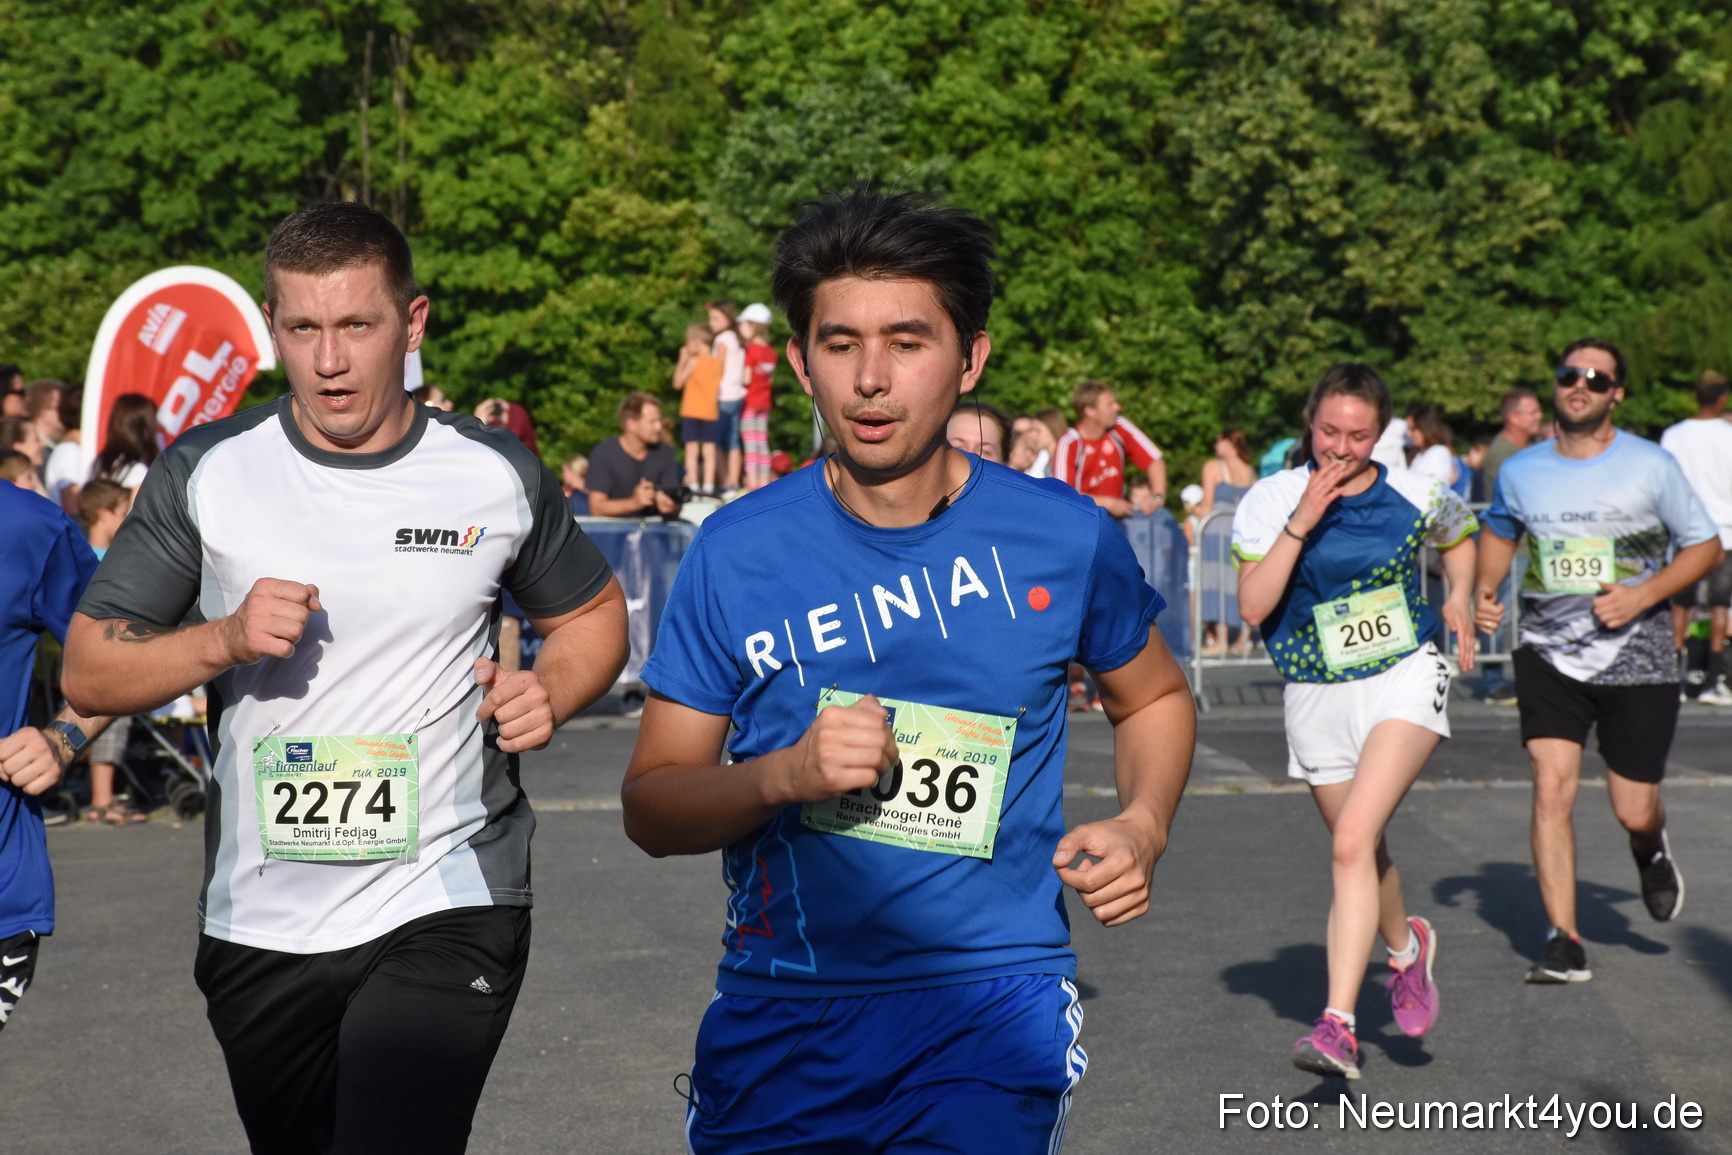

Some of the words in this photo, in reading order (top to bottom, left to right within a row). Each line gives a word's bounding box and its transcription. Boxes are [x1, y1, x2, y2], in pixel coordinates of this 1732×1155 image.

[137, 303, 173, 349] AVIA
[192, 355, 249, 427] nergie
[1561, 511, 1599, 523] ONE
[394, 527, 460, 547] swn
[394, 545, 439, 554] stadtwerke
[440, 547, 474, 556] neumarkt
[1549, 557, 1602, 578] 1939
[1340, 614, 1392, 648] 206
[944, 713, 977, 728] Gesunde
[275, 759, 338, 772] firmenlauf
[962, 751, 997, 766] 2019
[377, 767, 407, 777] 2019
[845, 758, 979, 814] 036
[273, 779, 396, 825] 2274
[839, 797, 922, 824] Brachvogel
[293, 827, 331, 841] Dmitrij
[334, 827, 377, 840] Fedjag
[835, 811, 861, 824] Rena
[864, 816, 928, 836] Technologies
[931, 828, 962, 840] GmbH
[269, 839, 300, 847] Stadtwerke
[358, 838, 385, 848] Energie
[386, 838, 407, 846] GmbH
